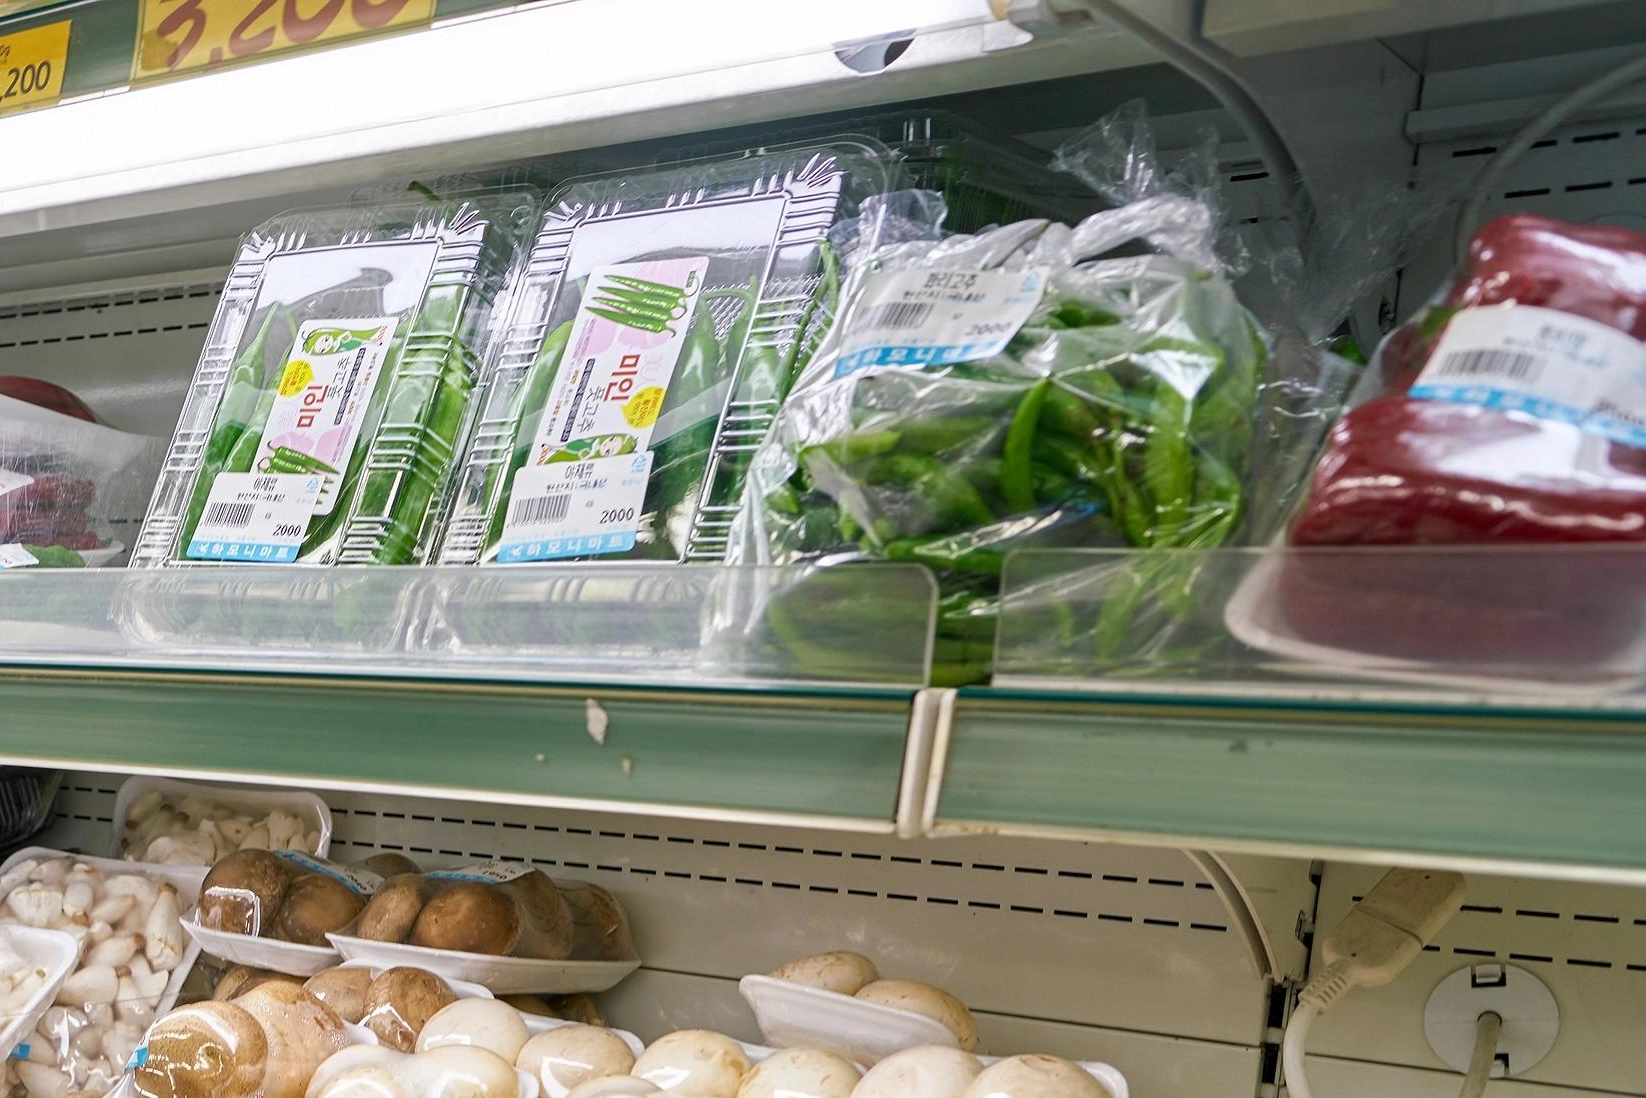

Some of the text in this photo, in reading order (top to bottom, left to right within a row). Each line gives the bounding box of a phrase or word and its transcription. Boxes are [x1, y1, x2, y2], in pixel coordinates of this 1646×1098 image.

[326, 356, 352, 400] 풋고추
[604, 354, 641, 402] 미인
[296, 384, 330, 429] 미인
[577, 386, 606, 434] 풋고추
[273, 523, 302, 538] 2000
[600, 506, 634, 526] 2000
[211, 542, 289, 559] 하모니마트
[526, 535, 625, 557] 하모니마트
